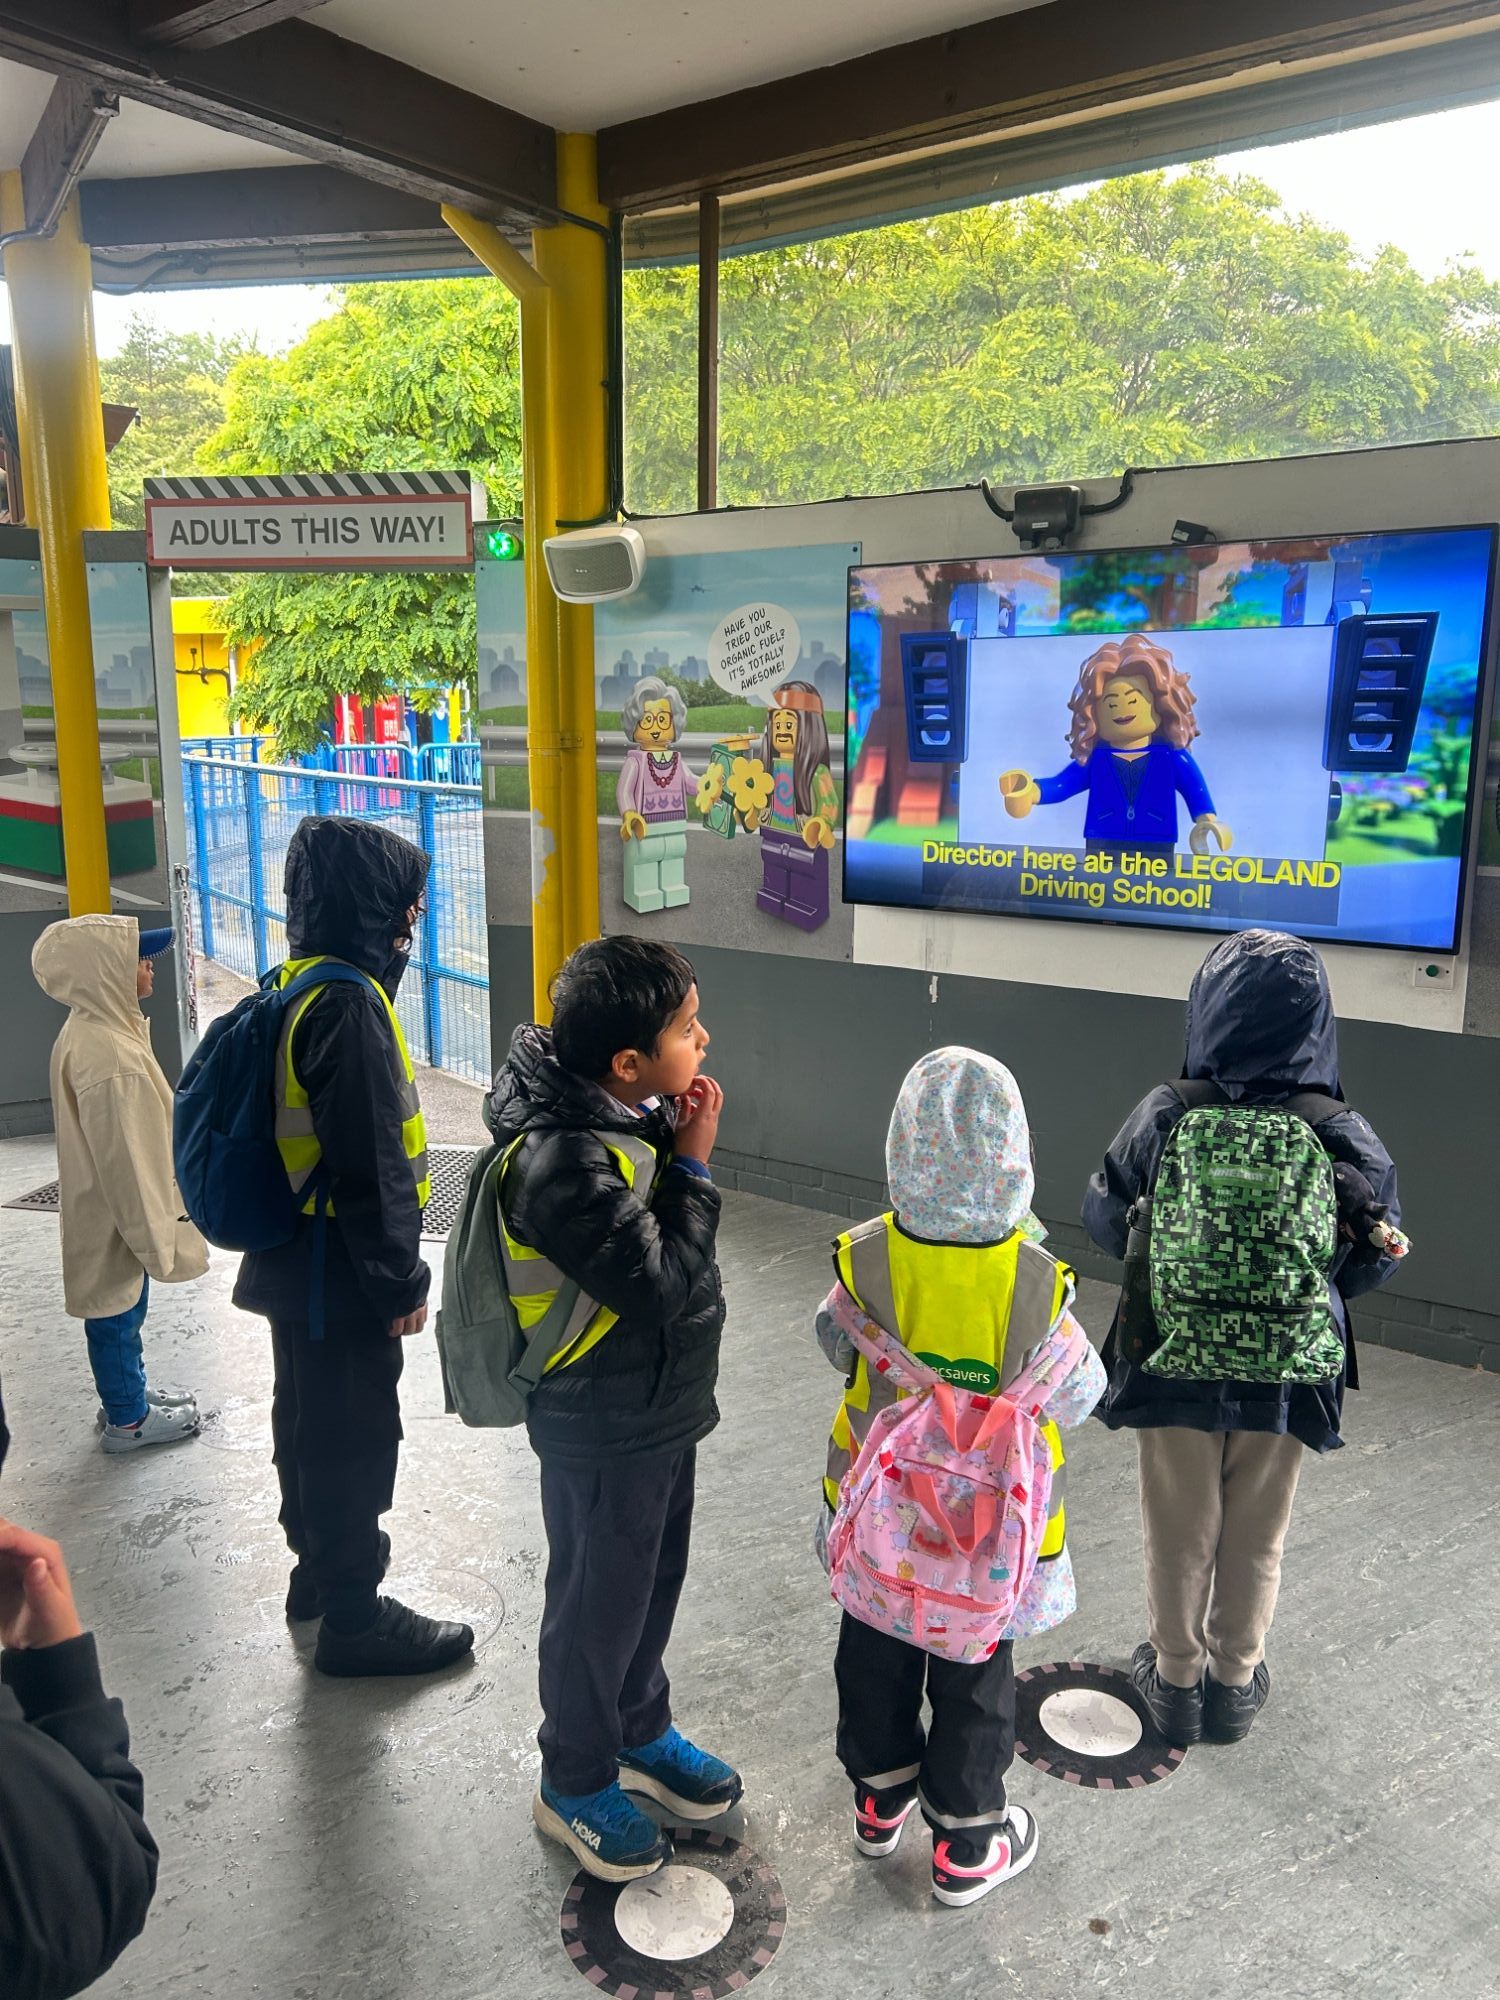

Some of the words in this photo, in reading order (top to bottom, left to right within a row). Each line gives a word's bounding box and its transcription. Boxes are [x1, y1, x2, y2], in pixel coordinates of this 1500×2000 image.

[169, 518, 281, 546] ADULTS
[291, 516, 360, 545] THIS
[370, 515, 445, 544] WAY!
[724, 618, 746, 637] HAVE
[748, 607, 766, 624] YOU
[725, 631, 751, 652] TRIED
[754, 620, 773, 637] OUR
[720, 644, 757, 670] ORGANIC
[759, 628, 786, 651] FUEL?
[728, 665, 745, 681] IT'S
[748, 644, 785, 671] TOTALLY
[741, 660, 785, 691] AWESOME!
[922, 840, 1017, 868] Director
[1023, 845, 1077, 871] here
[1083, 851, 1114, 874] at
[1120, 851, 1168, 878] the
[1175, 854, 1341, 888] LEGOLAND
[1020, 872, 1106, 908] Driving
[1112, 878, 1212, 909] School!
[931, 1366, 991, 1384] ecsavers
[571, 1817, 602, 1850] HOKA
